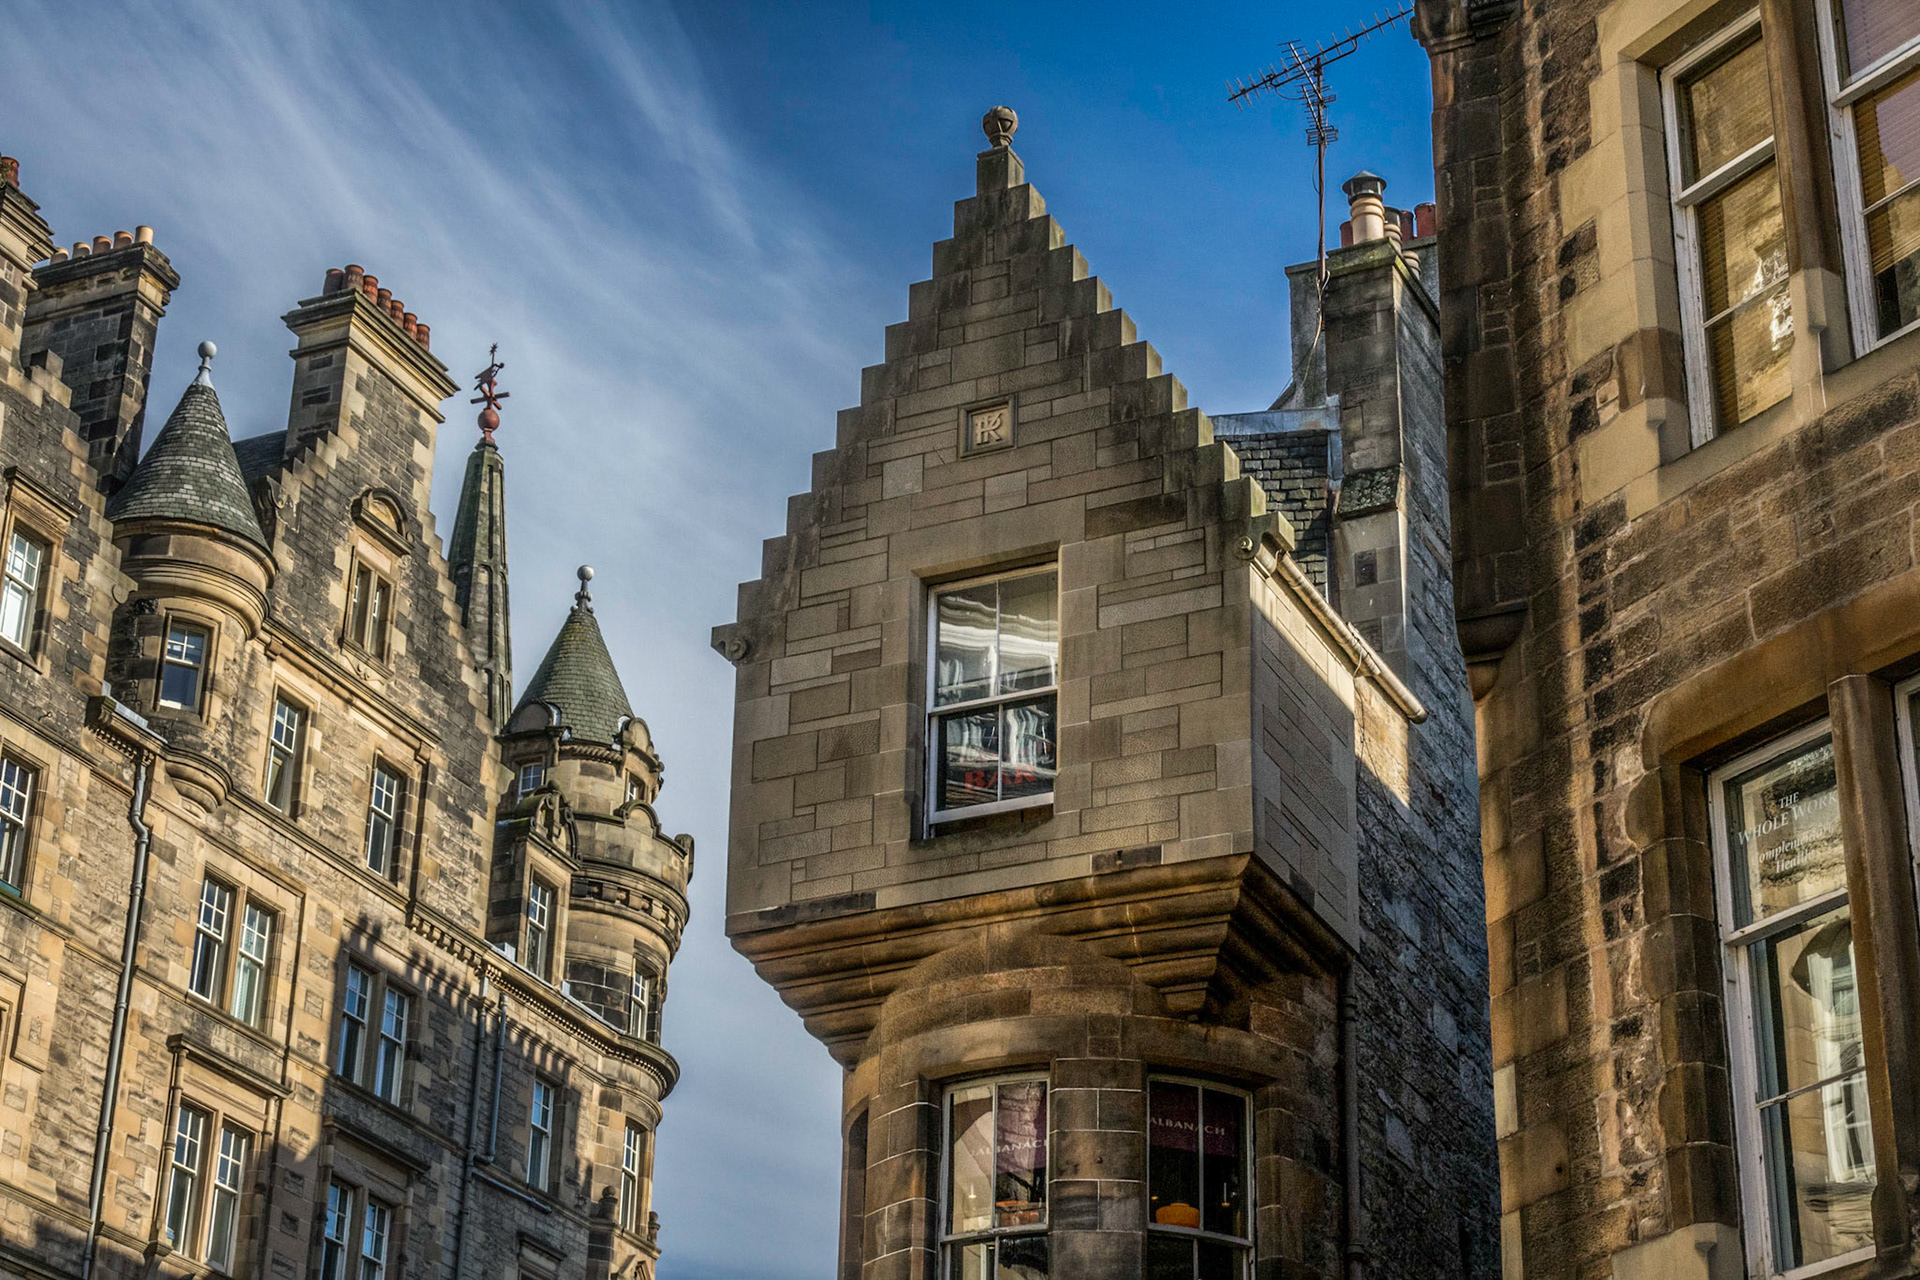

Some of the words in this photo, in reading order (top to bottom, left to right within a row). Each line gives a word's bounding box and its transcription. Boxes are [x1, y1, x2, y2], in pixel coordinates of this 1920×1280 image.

[964, 761, 1037, 791] BAR
[1778, 791, 1800, 809] THE
[1738, 811, 1789, 845] WHOLE
[1754, 823, 1834, 866] omplementary
